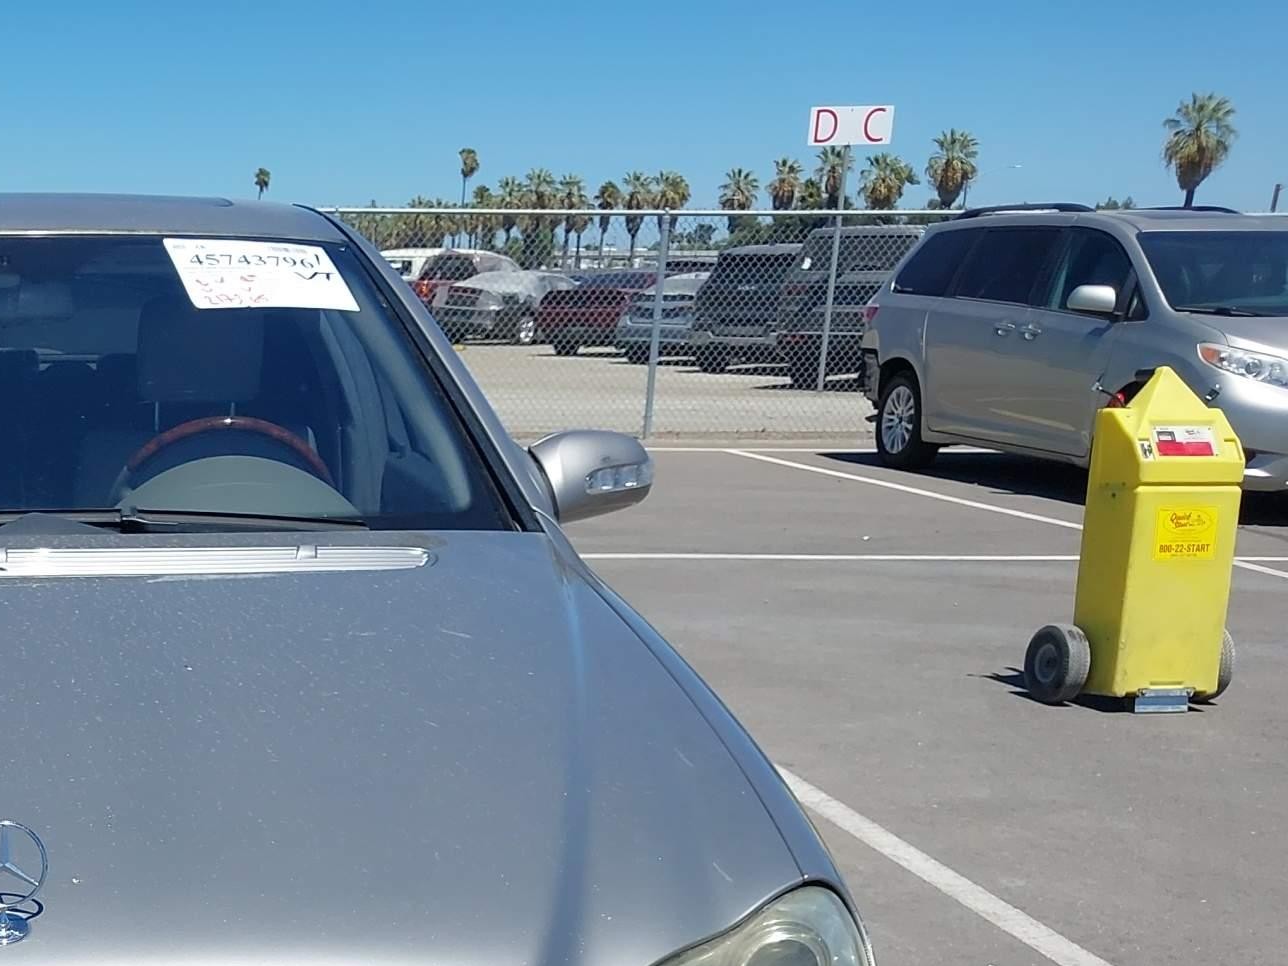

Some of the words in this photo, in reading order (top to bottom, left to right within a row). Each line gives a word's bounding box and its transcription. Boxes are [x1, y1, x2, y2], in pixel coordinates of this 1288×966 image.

[813, 108, 838, 143] D
[863, 107, 887, 142] C
[189, 253, 314, 269] 45743796
